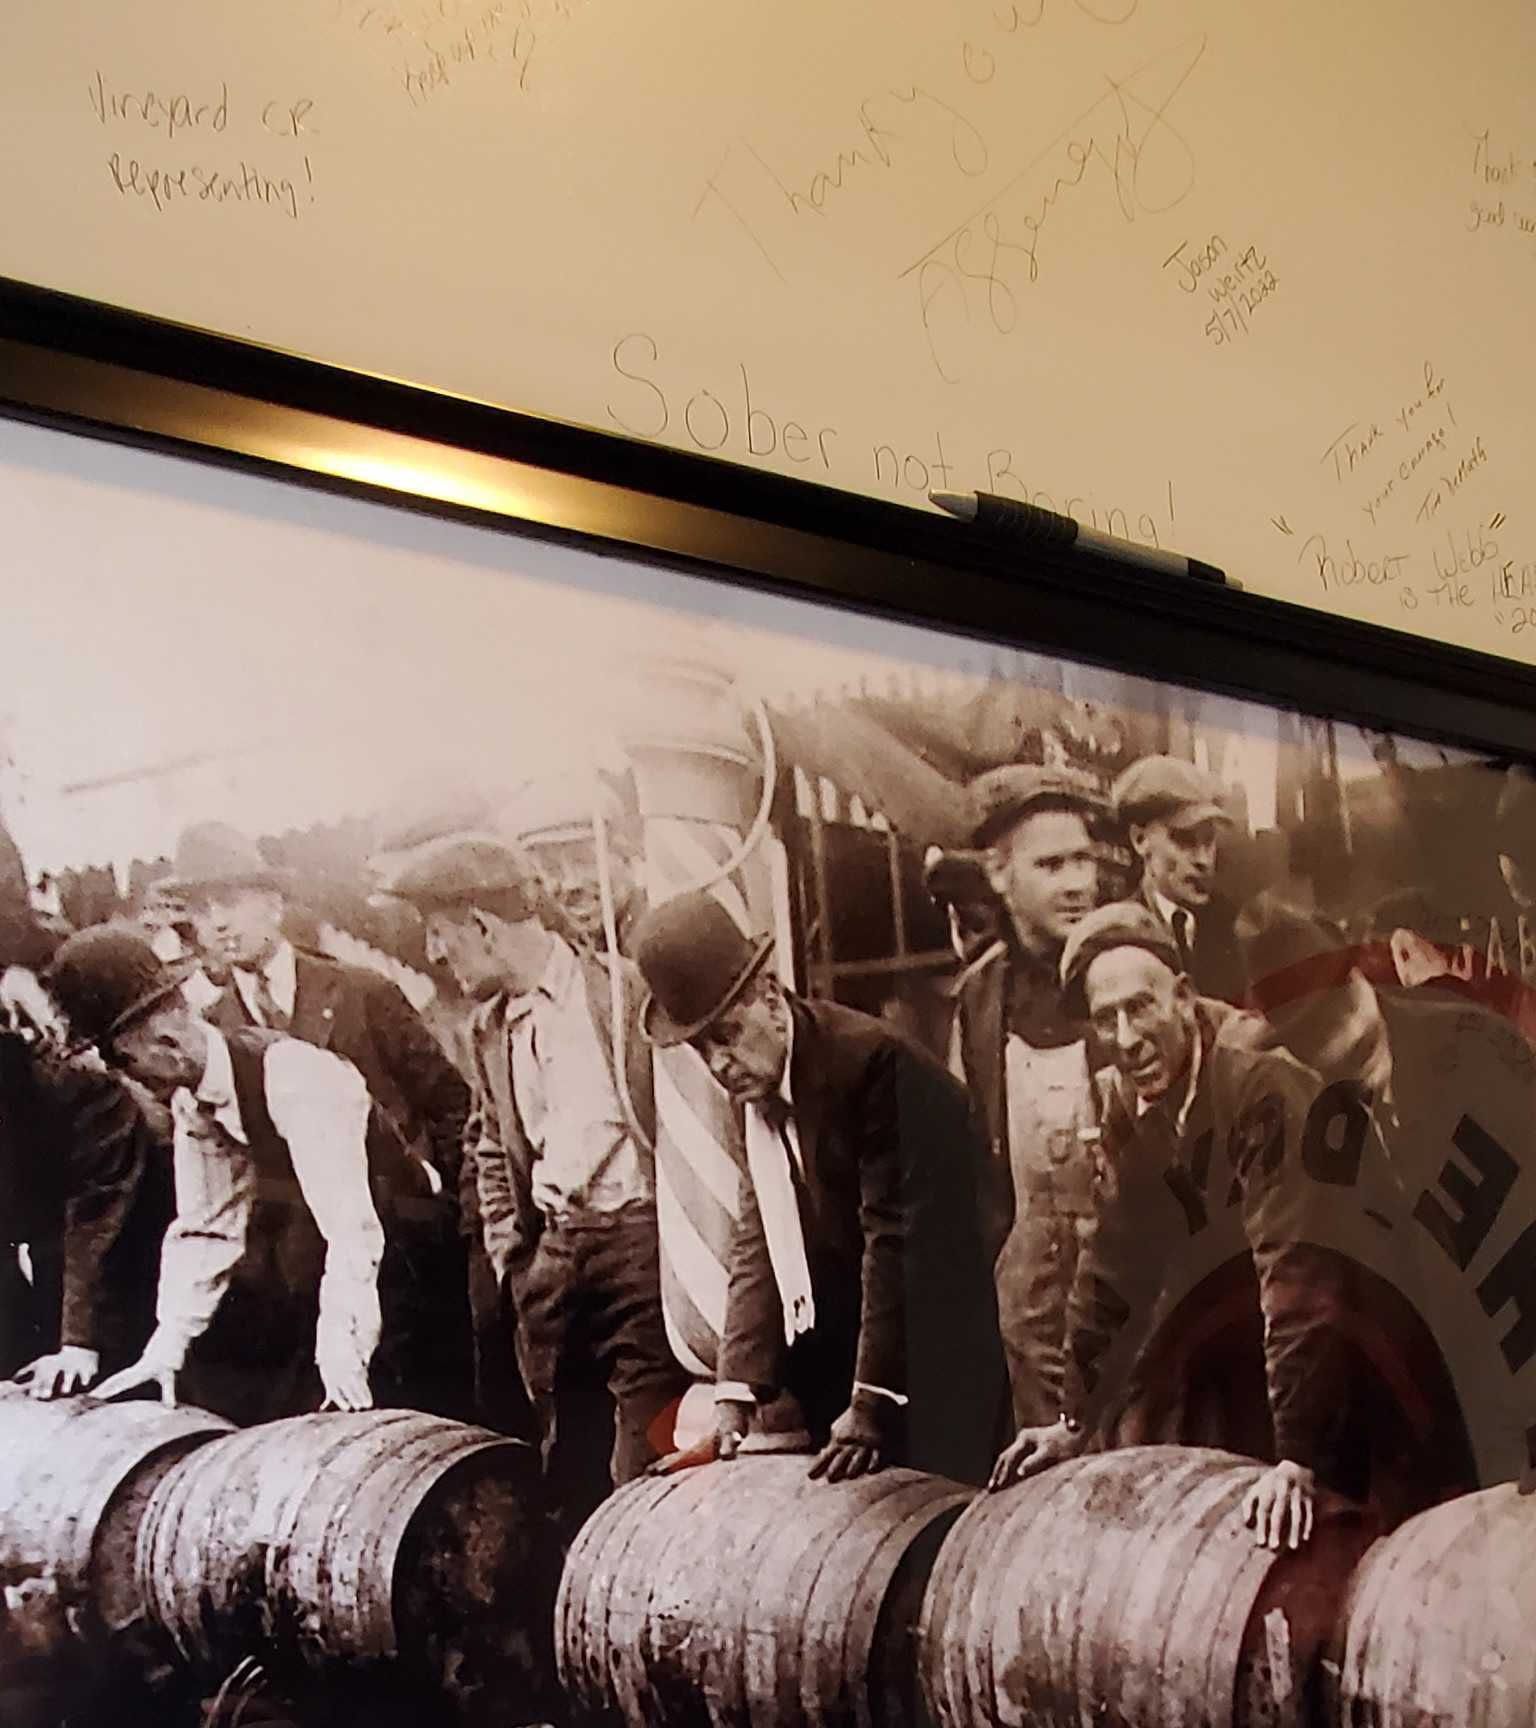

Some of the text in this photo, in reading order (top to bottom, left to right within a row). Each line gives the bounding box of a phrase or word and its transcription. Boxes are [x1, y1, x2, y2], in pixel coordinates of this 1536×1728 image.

[89, 70, 228, 139] Vineyard
[1163, 232, 1228, 295] Jason
[606, 332, 838, 470] Sober
[874, 431, 955, 493] not
[1319, 422, 1386, 481] Thank
